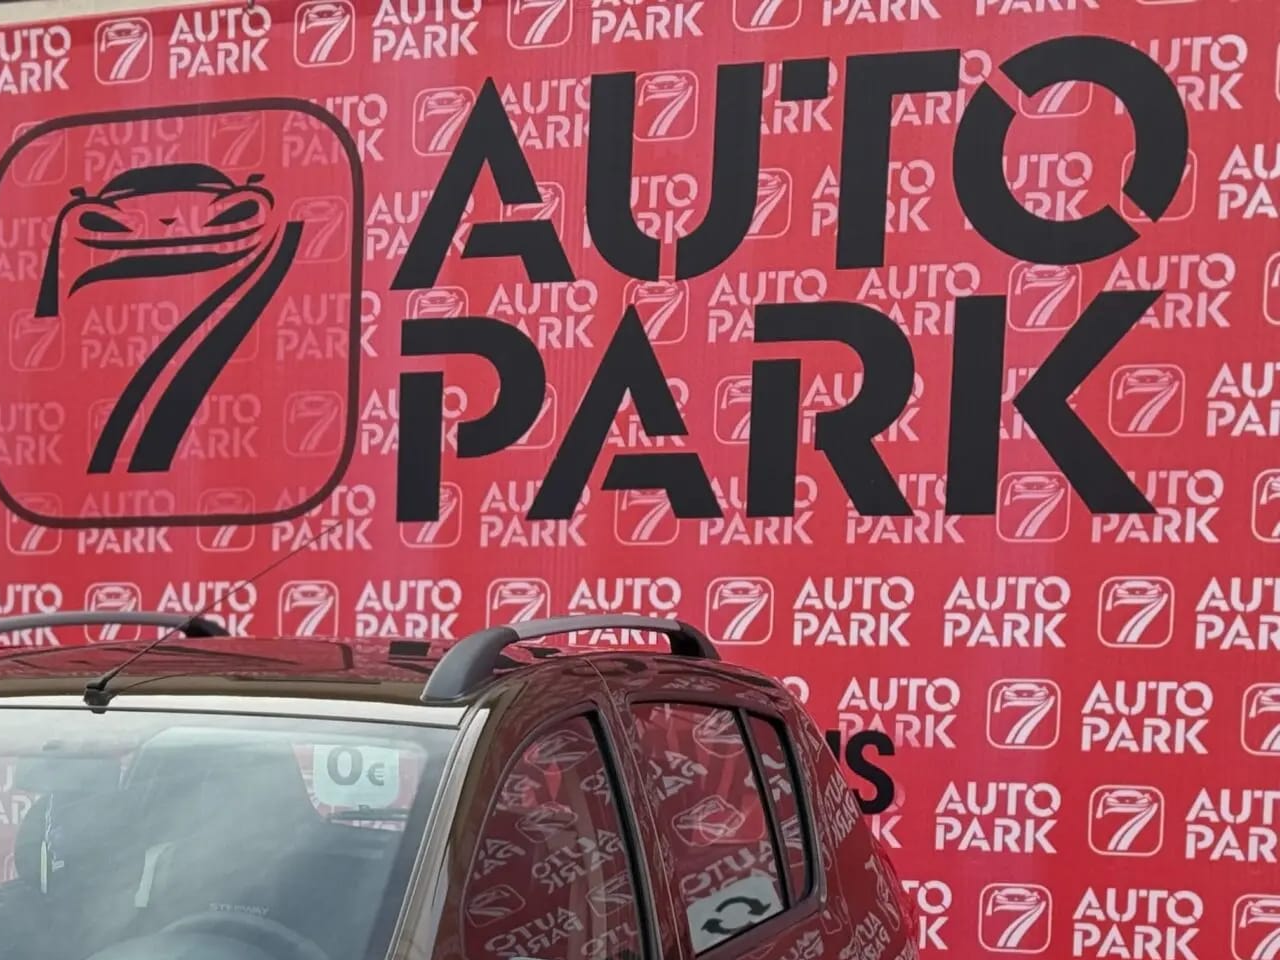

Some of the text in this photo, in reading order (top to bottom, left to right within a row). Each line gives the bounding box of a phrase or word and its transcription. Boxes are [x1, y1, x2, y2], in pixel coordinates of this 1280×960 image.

[169, 5, 271, 45] AUTO
[591, 3, 704, 44] PARK
[170, 38, 268, 79] PARK
[373, 22, 478, 62] PARK
[390, 36, 1188, 290] AUTO
[708, 269, 827, 306] AUTO
[857, 262, 980, 301] AUTO
[1108, 253, 1236, 291] AUTO
[277, 291, 381, 326] AUTO
[487, 280, 598, 315] AUTO
[1135, 292, 1232, 328] ARK
[276, 325, 378, 359] PARK
[396, 290, 1165, 522] PARK
[77, 522, 174, 553] PARK
[271, 519, 373, 551] PARK
[480, 521, 587, 547] PARK
[699, 514, 814, 545] PARK
[846, 512, 965, 545] PARK
[1091, 511, 1220, 544] PARK
[156, 580, 257, 613] AUTO
[355, 579, 462, 613] AUTO
[568, 577, 682, 611] AUTO
[793, 577, 914, 610] AUTO
[944, 576, 1070, 610] AUTO
[355, 612, 460, 640] PARK
[794, 612, 910, 646] PARK
[944, 613, 1066, 647] PARK
[1195, 614, 1280, 650] PAR
[838, 677, 960, 712] AUTO
[1082, 680, 1213, 716] AUTO
[1082, 717, 1208, 754] PARK
[936, 782, 1061, 817] AUTO
[1186, 787, 1280, 825] AUT
[936, 817, 1056, 853] PARK
[1185, 824, 1280, 862] PAR
[1073, 888, 1203, 925] AUTO
